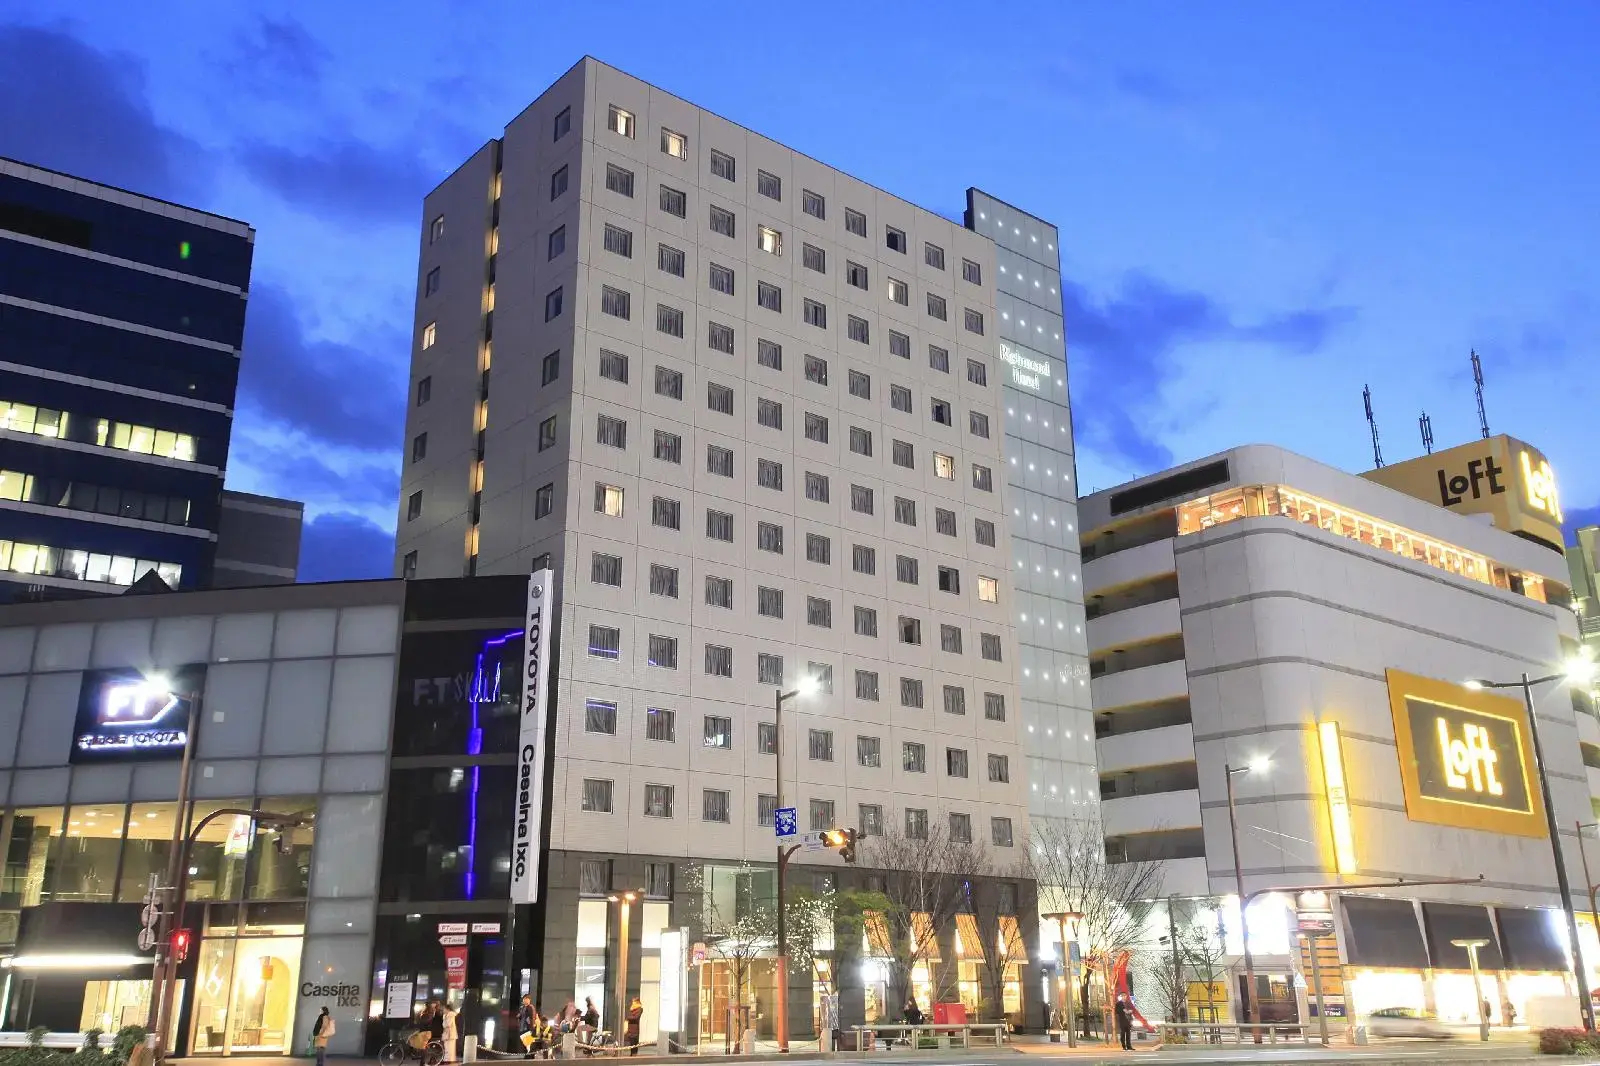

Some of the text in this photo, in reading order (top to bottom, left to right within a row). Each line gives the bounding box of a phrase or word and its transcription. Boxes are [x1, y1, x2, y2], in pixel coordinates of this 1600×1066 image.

[525, 606, 541, 716] TOYOTA
[517, 744, 535, 839] Cassina
[300, 981, 360, 997] Cassina
